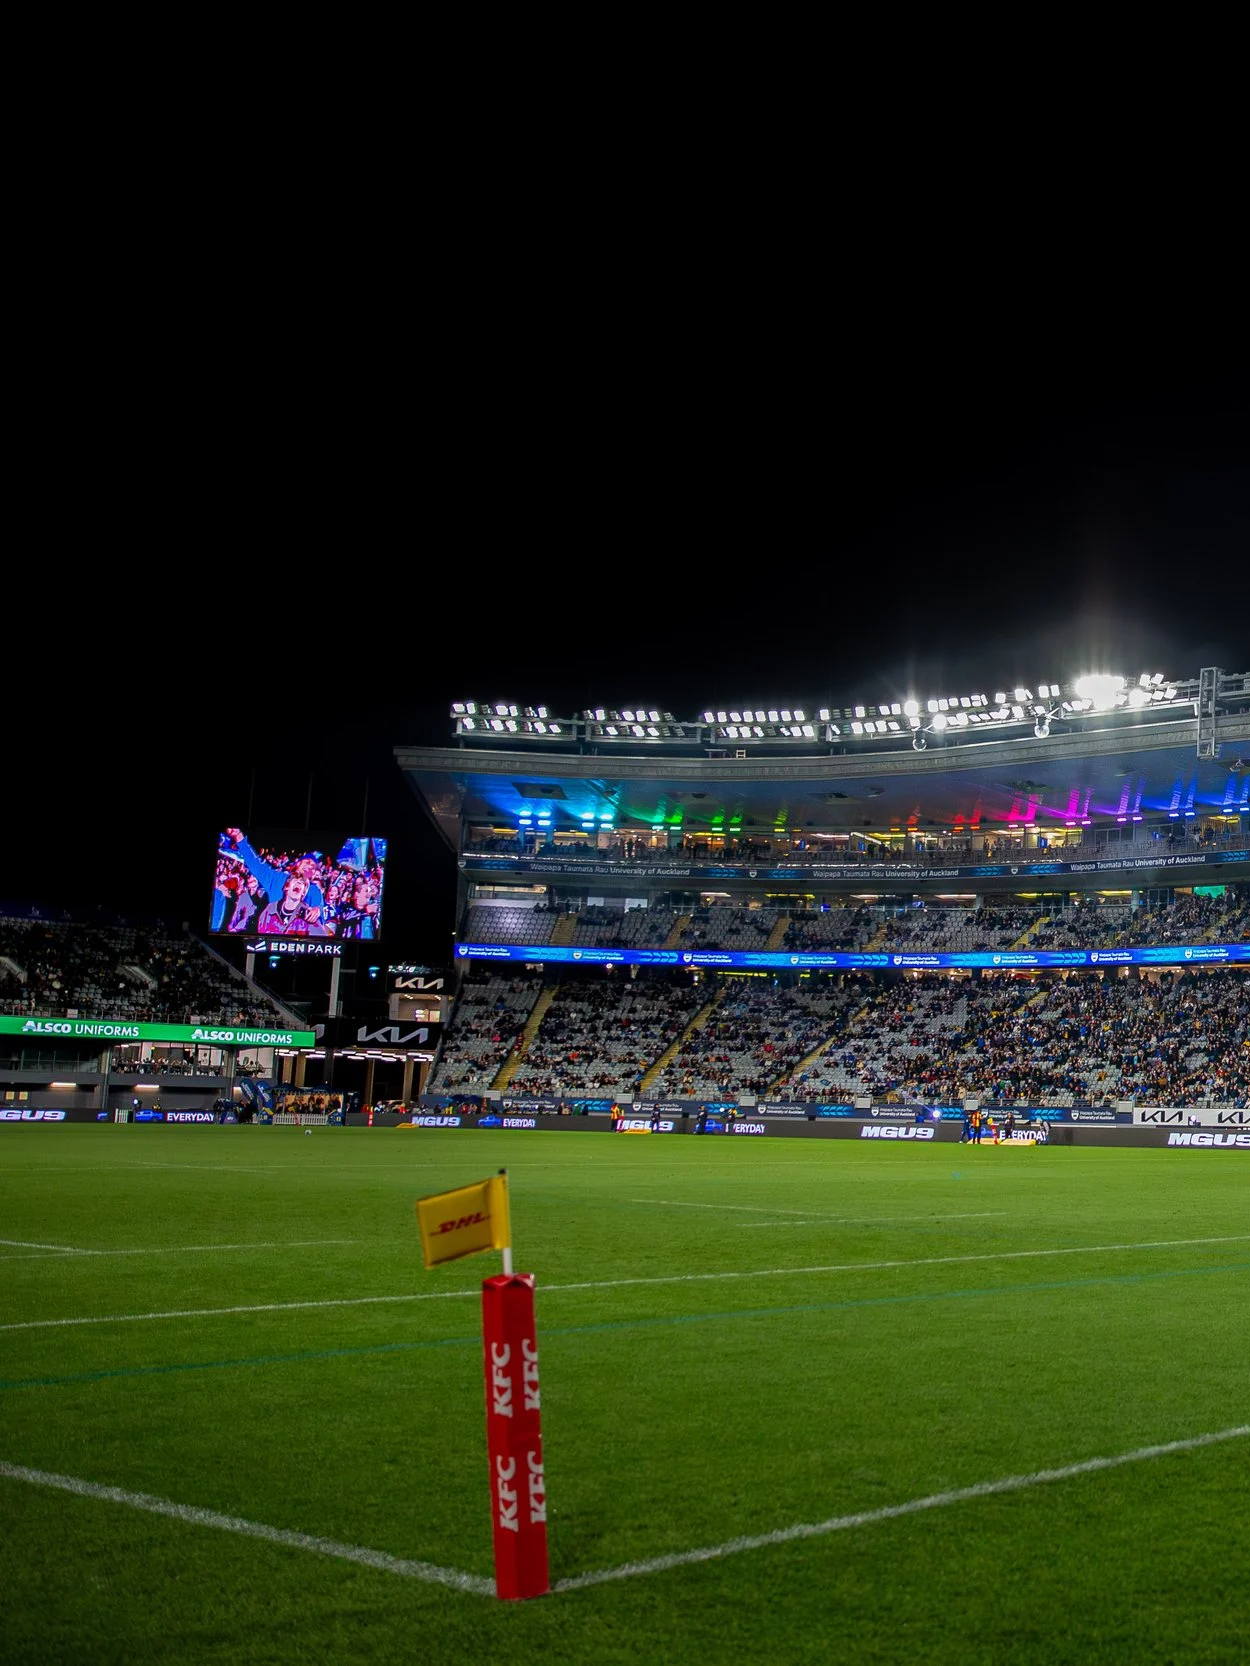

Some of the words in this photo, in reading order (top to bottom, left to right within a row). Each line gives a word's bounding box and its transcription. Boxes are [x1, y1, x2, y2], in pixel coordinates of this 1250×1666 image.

[1135, 858, 1166, 866] University
[1175, 856, 1205, 864] Auckland
[271, 943, 304, 952] EDEN
[308, 945, 341, 954] PARK
[396, 977, 444, 989] KIA
[22, 1020, 71, 1033] ALSCO
[76, 1024, 139, 1037] UNIFORMS
[358, 1026, 428, 1043] KIA
[191, 1028, 233, 1041] ALSCO
[237, 1032, 292, 1044] UNIFORMS
[167, 1112, 214, 1122] EVERYDAY
[412, 1117, 461, 1126] MGU9
[503, 1119, 535, 1127] EVERYDAY
[1141, 1111, 1183, 1122] KIA
[861, 1126, 934, 1139] MGU9
[436, 1212, 485, 1234] DHL
[491, 1342, 513, 1418] KFC
[522, 1338, 540, 1411] KFC
[496, 1454, 519, 1533] KFC
[527, 1450, 547, 1524] KFC
